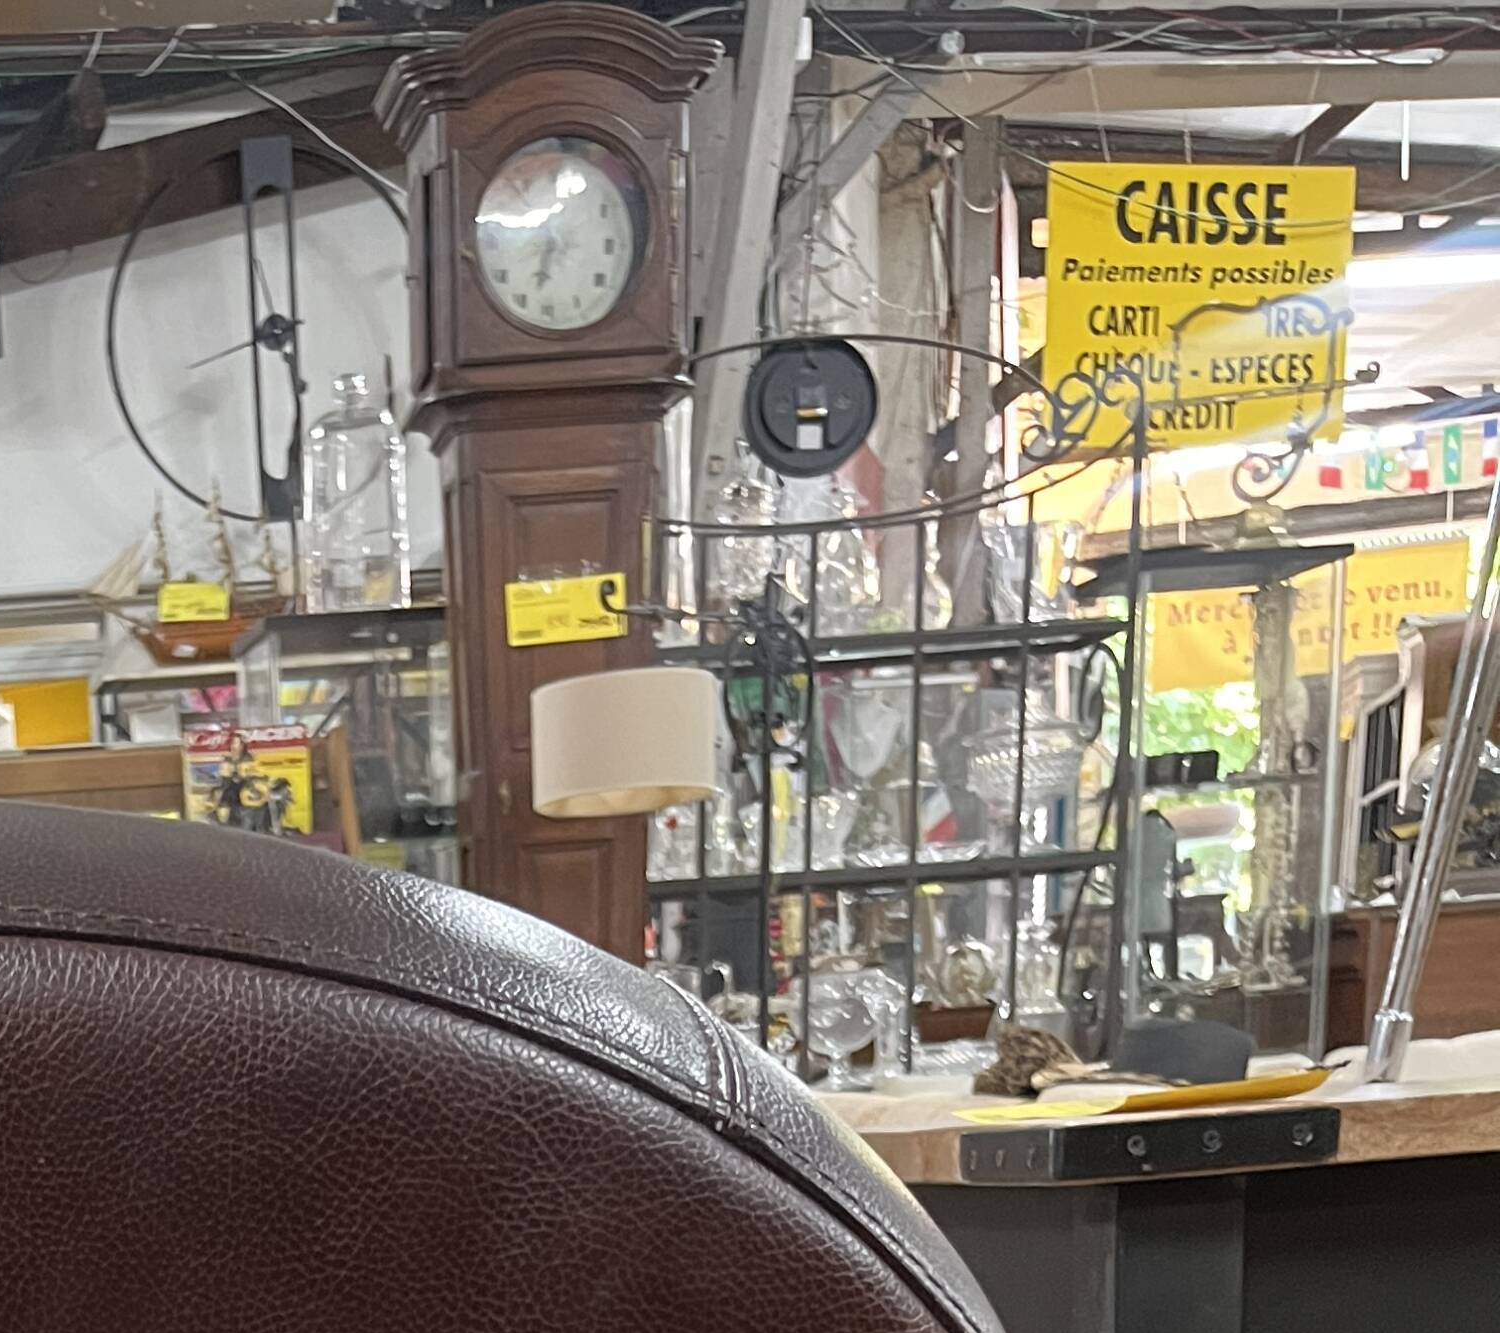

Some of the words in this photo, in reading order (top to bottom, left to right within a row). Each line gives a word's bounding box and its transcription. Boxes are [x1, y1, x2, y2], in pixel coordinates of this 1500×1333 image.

[1116, 180, 1288, 245] CAISSE
[1062, 258, 1202, 284] Paiements
[1209, 261, 1334, 289] possibles
[1211, 353, 1314, 384] ESPECES
[1167, 601, 1245, 627] Merc
[1366, 580, 1453, 603] venu,
